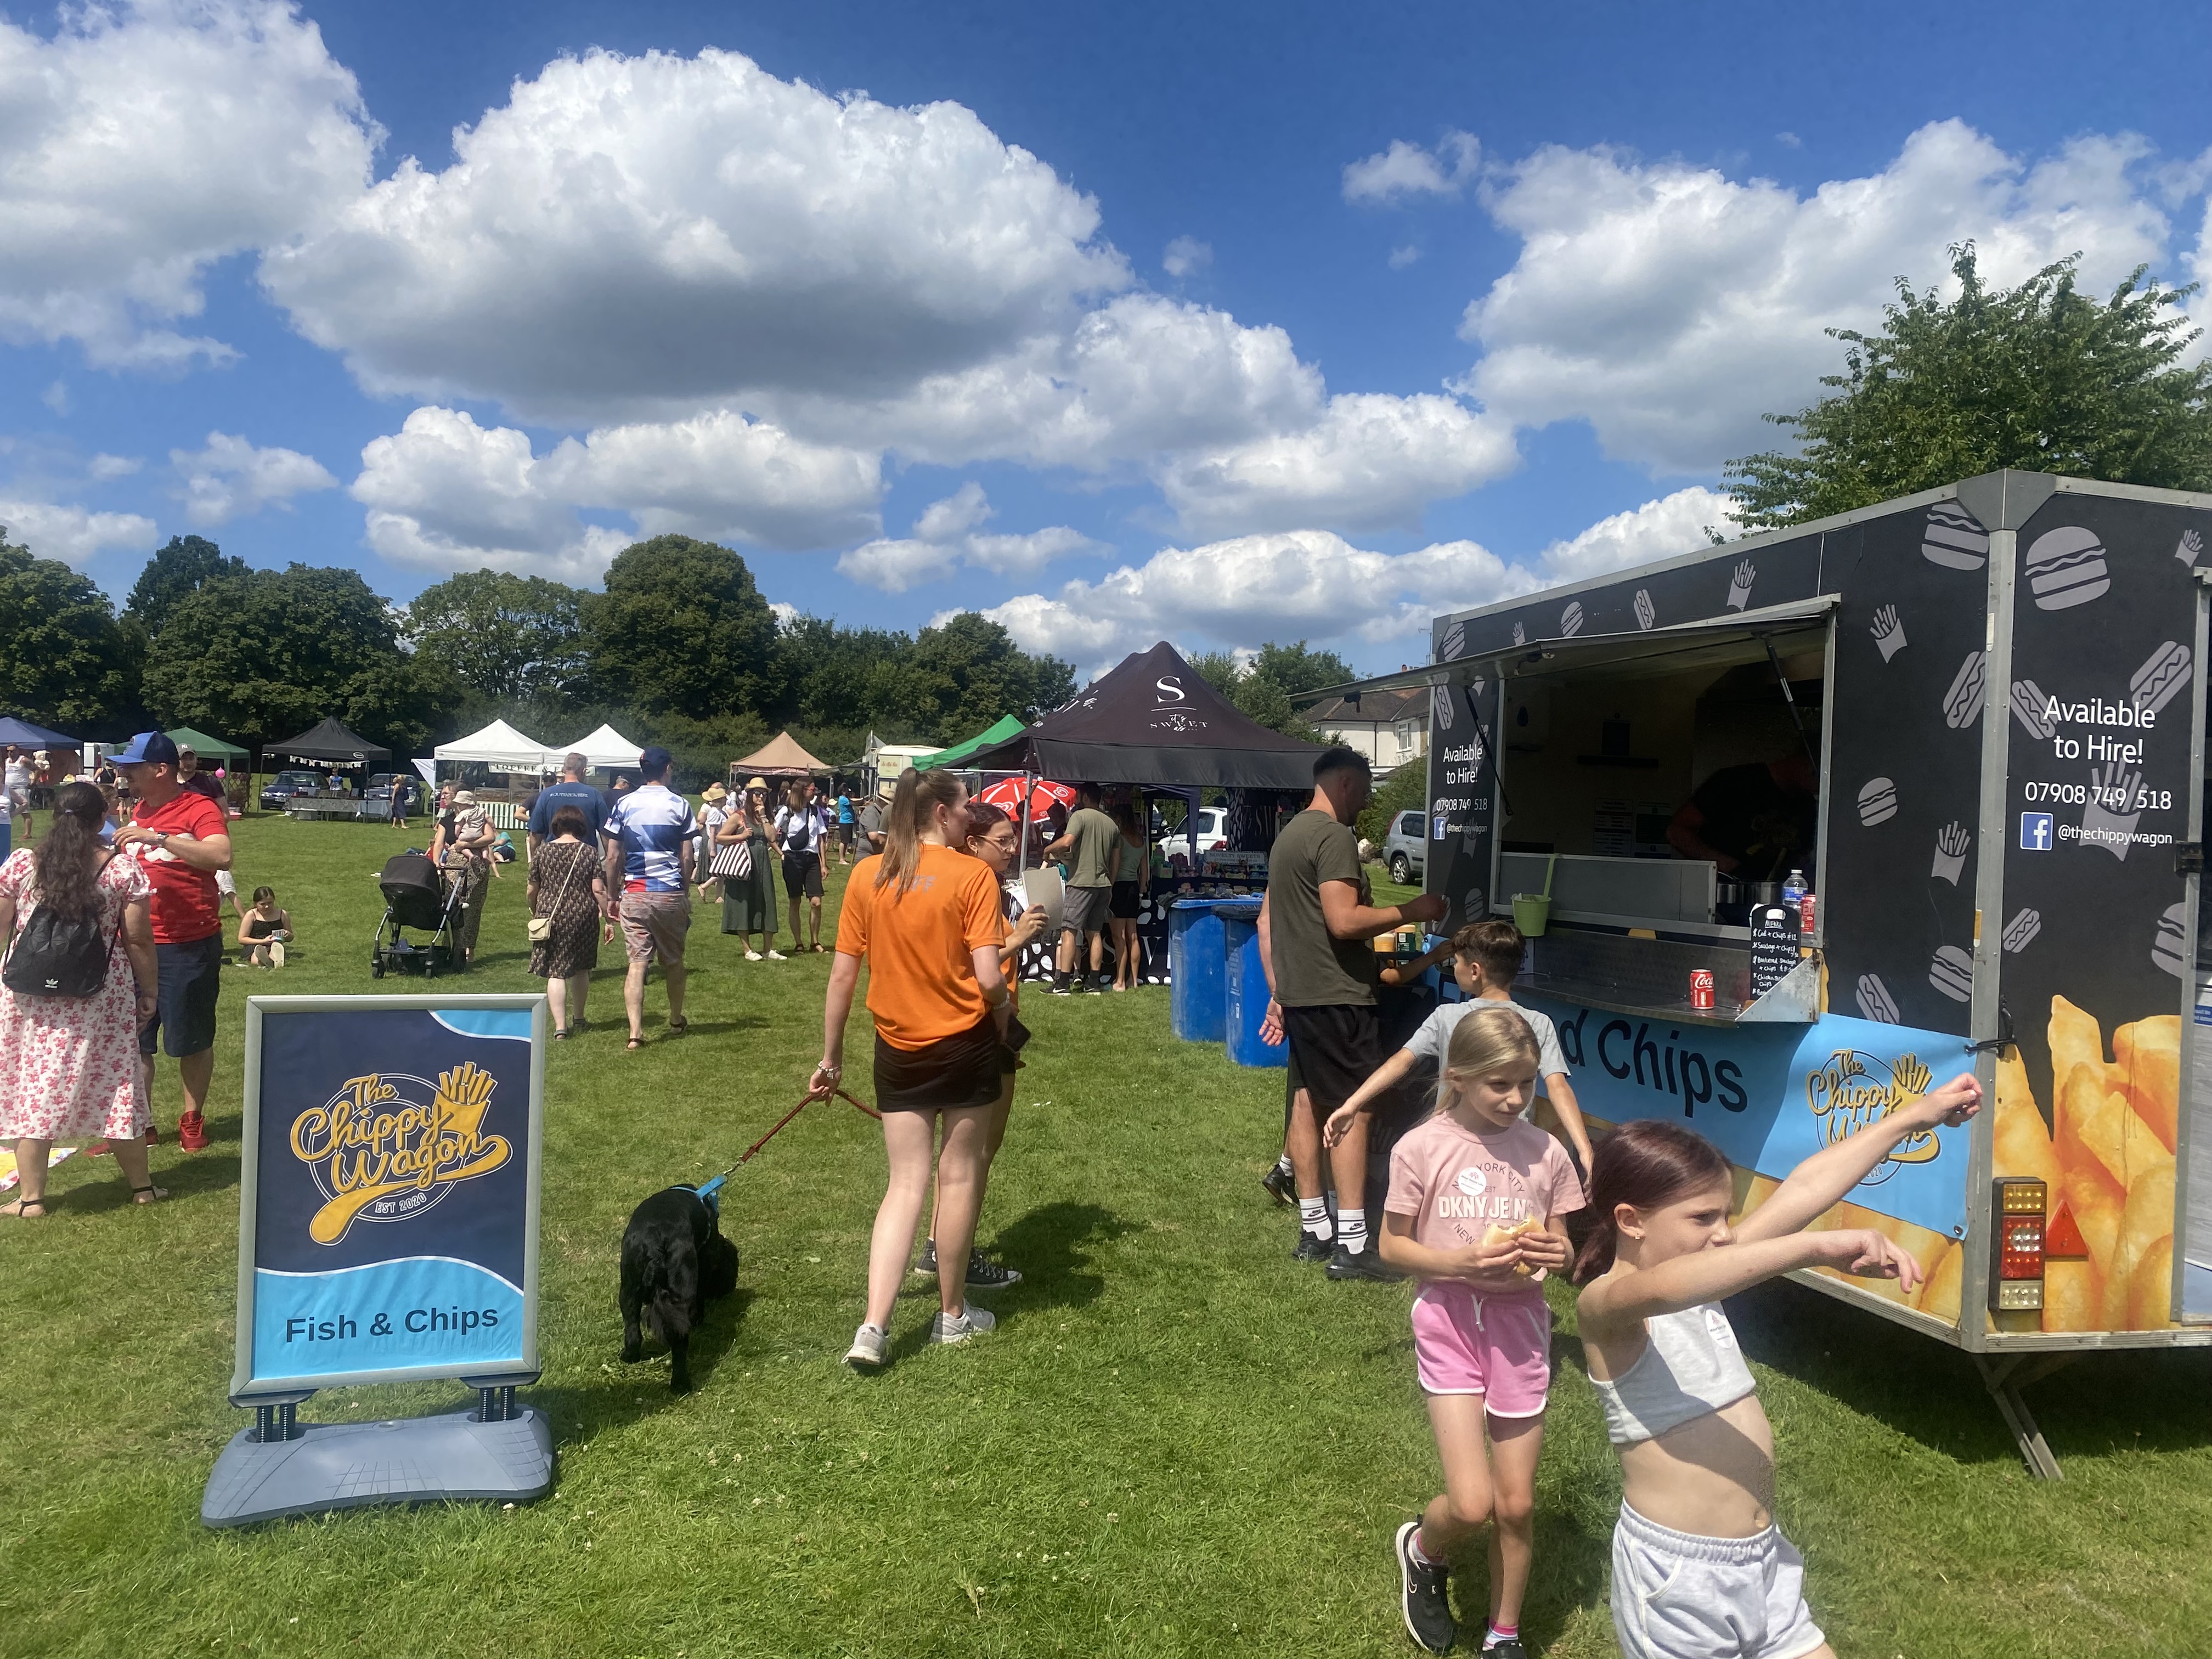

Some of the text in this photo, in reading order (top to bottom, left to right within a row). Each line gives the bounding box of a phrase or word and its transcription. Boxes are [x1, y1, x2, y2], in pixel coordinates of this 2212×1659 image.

[1156, 675, 1185, 703] S
[2043, 695, 2156, 729] Available
[1443, 743, 1483, 763] Available
[2053, 735, 2143, 764] to Hire!
[1446, 766, 1479, 785] to Hire!
[1436, 798, 1488, 811] 07908 749 518
[2025, 782, 2172, 810] 07908 749 518
[1447, 823, 1487, 835] @thechippywagon
[2058, 824, 2173, 847] @thechippywagon
[1597, 1019, 1748, 1119] Chips
[1831, 1048, 1866, 1086] The
[344, 1074, 399, 1108] The
[1806, 1068, 1902, 1122] Chippy
[290, 1099, 452, 1162] Chippy
[332, 1131, 484, 1189] Wagon
[1509, 1171, 1525, 1193] CITY
[375, 1192, 427, 1214] EST 2020
[1438, 1196, 1488, 1219] DKNY
[1454, 1223, 1475, 1245] NEW
[286, 1307, 499, 1344] Fish & Chips
